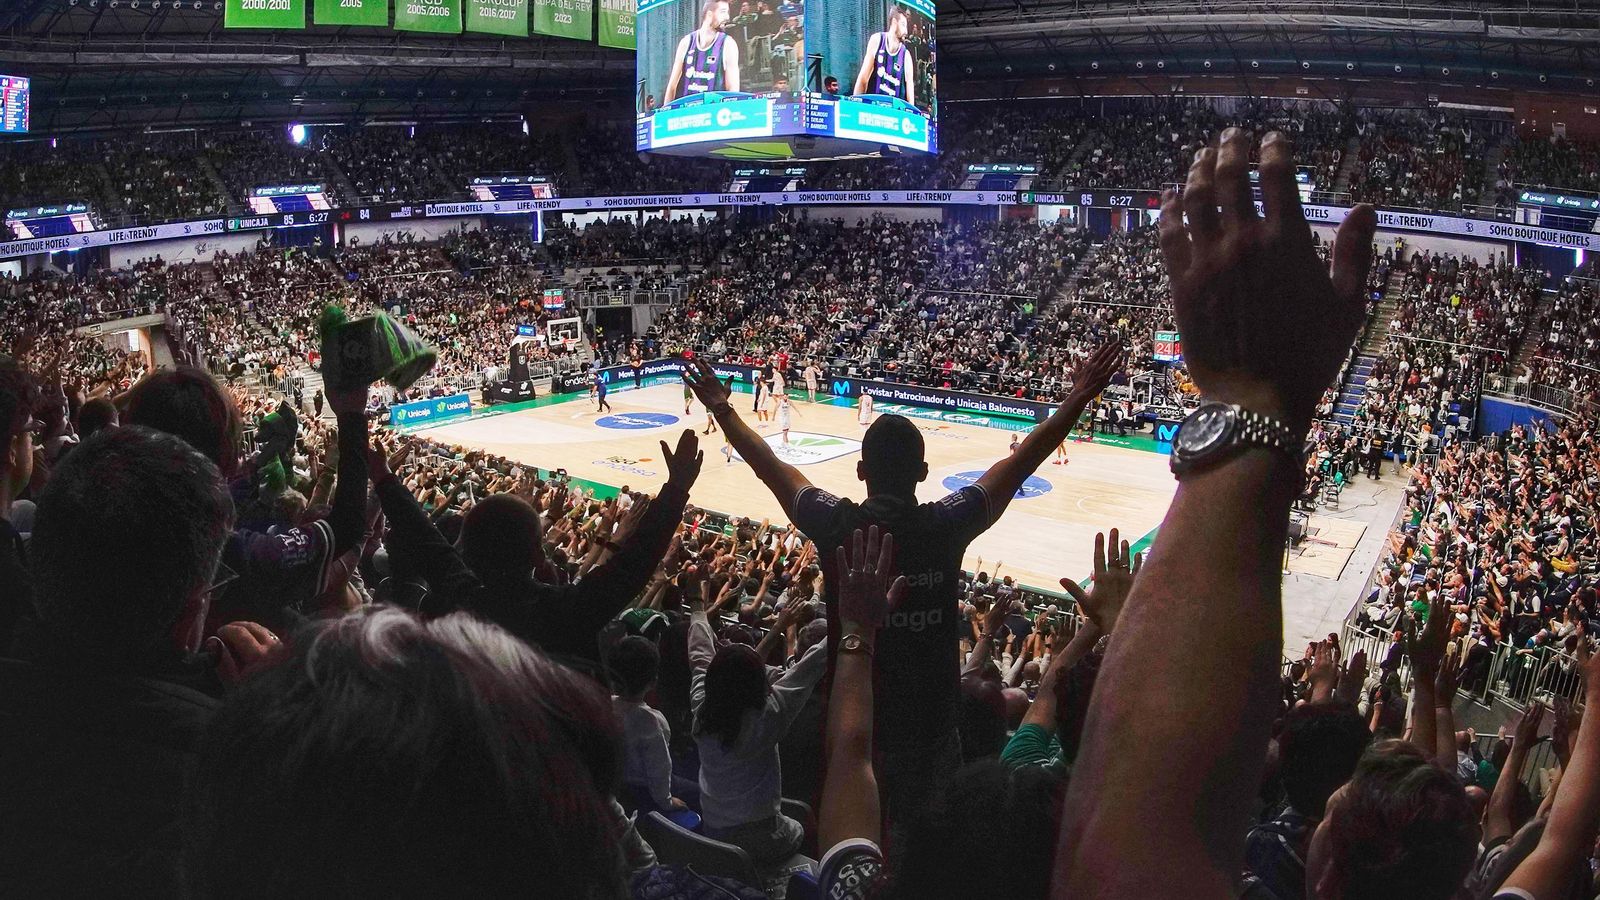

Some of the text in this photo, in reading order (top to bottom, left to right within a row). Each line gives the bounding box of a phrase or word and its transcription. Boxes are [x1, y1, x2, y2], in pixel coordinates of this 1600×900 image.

[407, 4, 450, 16] 2005/2006
[575, 2, 591, 12] REY
[479, 7, 517, 19] 2016/2017
[554, 13, 572, 23] 2023
[617, 25, 634, 36] 2024
[603, 196, 683, 207] SOHO BOUTIQUE HOTELS
[718, 195, 732, 203] LIFE
[736, 194, 761, 202] TRENDY
[799, 193, 815, 201] SOHO
[816, 193, 847, 201] BOUTIQUE
[906, 193, 921, 201] LIFE
[926, 192, 953, 201] TRENDY
[997, 193, 1017, 202] SOHO
[1034, 194, 1065, 203] UNICAJA
[1081, 193, 1093, 205] 85
[1110, 196, 1133, 207] 6:27
[427, 202, 483, 214] BOUTIQUE HOTELS
[517, 201, 531, 210] LIFE
[535, 199, 561, 209] TRENDY
[1305, 207, 1329, 218] OTELS
[240, 218, 269, 228] UNICAJA
[283, 214, 294, 225] 85
[309, 212, 329, 223] 6:27
[359, 209, 370, 219] 84
[1376, 211, 1391, 222] LIFE
[1399, 214, 1434, 228] TRENDY
[204, 222, 225, 232] SOHO
[109, 230, 125, 242] LIFE
[130, 228, 159, 240] TRENDY
[1490, 224, 1590, 247] SOHO BOUTIQUE HOTELS
[11, 240, 44, 254] BOUTIQUE
[45, 238, 70, 251] HOTELS
[1157, 342, 1172, 355] 24
[645, 363, 680, 374] Patrocinador
[713, 368, 743, 378] aloncesto
[446, 401, 469, 411] Unicaja
[894, 390, 944, 405] Patrocinador
[945, 396, 956, 407] de
[957, 398, 987, 411] Unicaja
[988, 402, 1035, 417] Baloncesto
[407, 408, 431, 419] Unicaja
[906, 569, 944, 590] caja
